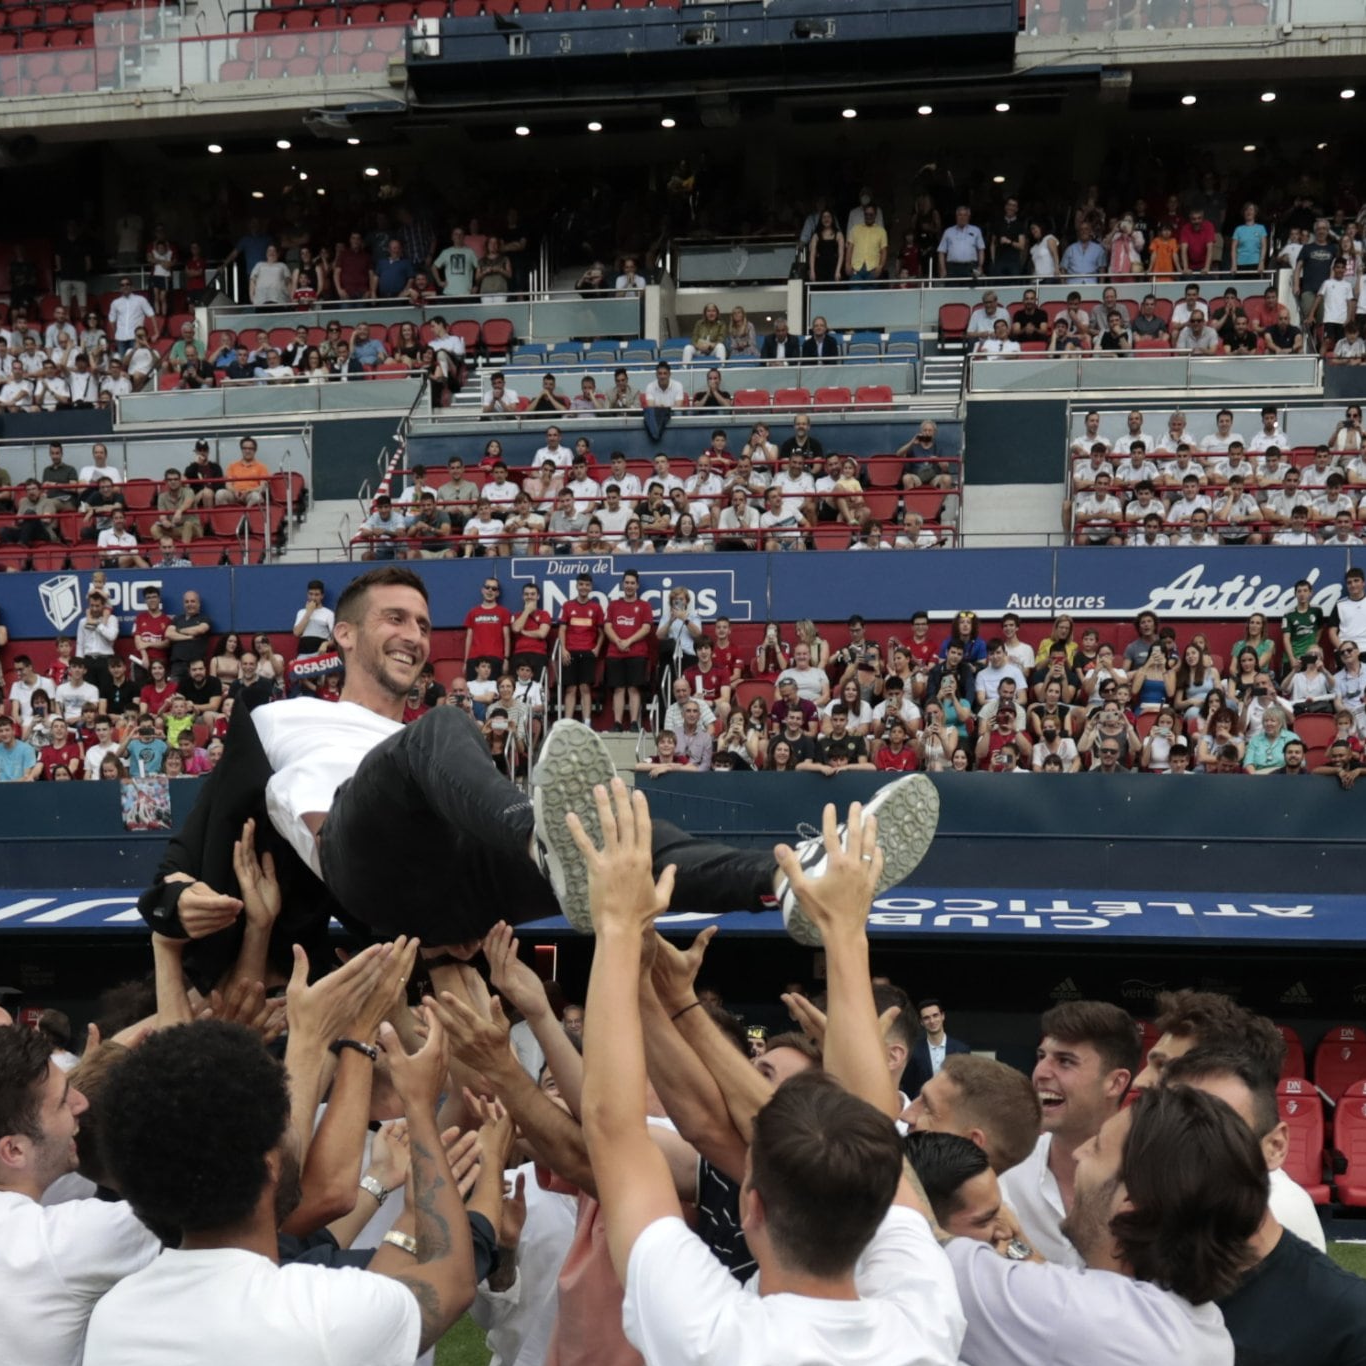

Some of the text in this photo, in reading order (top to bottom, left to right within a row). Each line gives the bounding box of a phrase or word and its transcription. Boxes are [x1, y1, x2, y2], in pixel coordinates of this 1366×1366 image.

[547, 559, 609, 575] Diario de
[1006, 592, 1106, 609] Autocares
[868, 912, 1111, 930] CLUB
[1340, 1028, 1355, 1037] DN
[1286, 1081, 1301, 1090] DN
